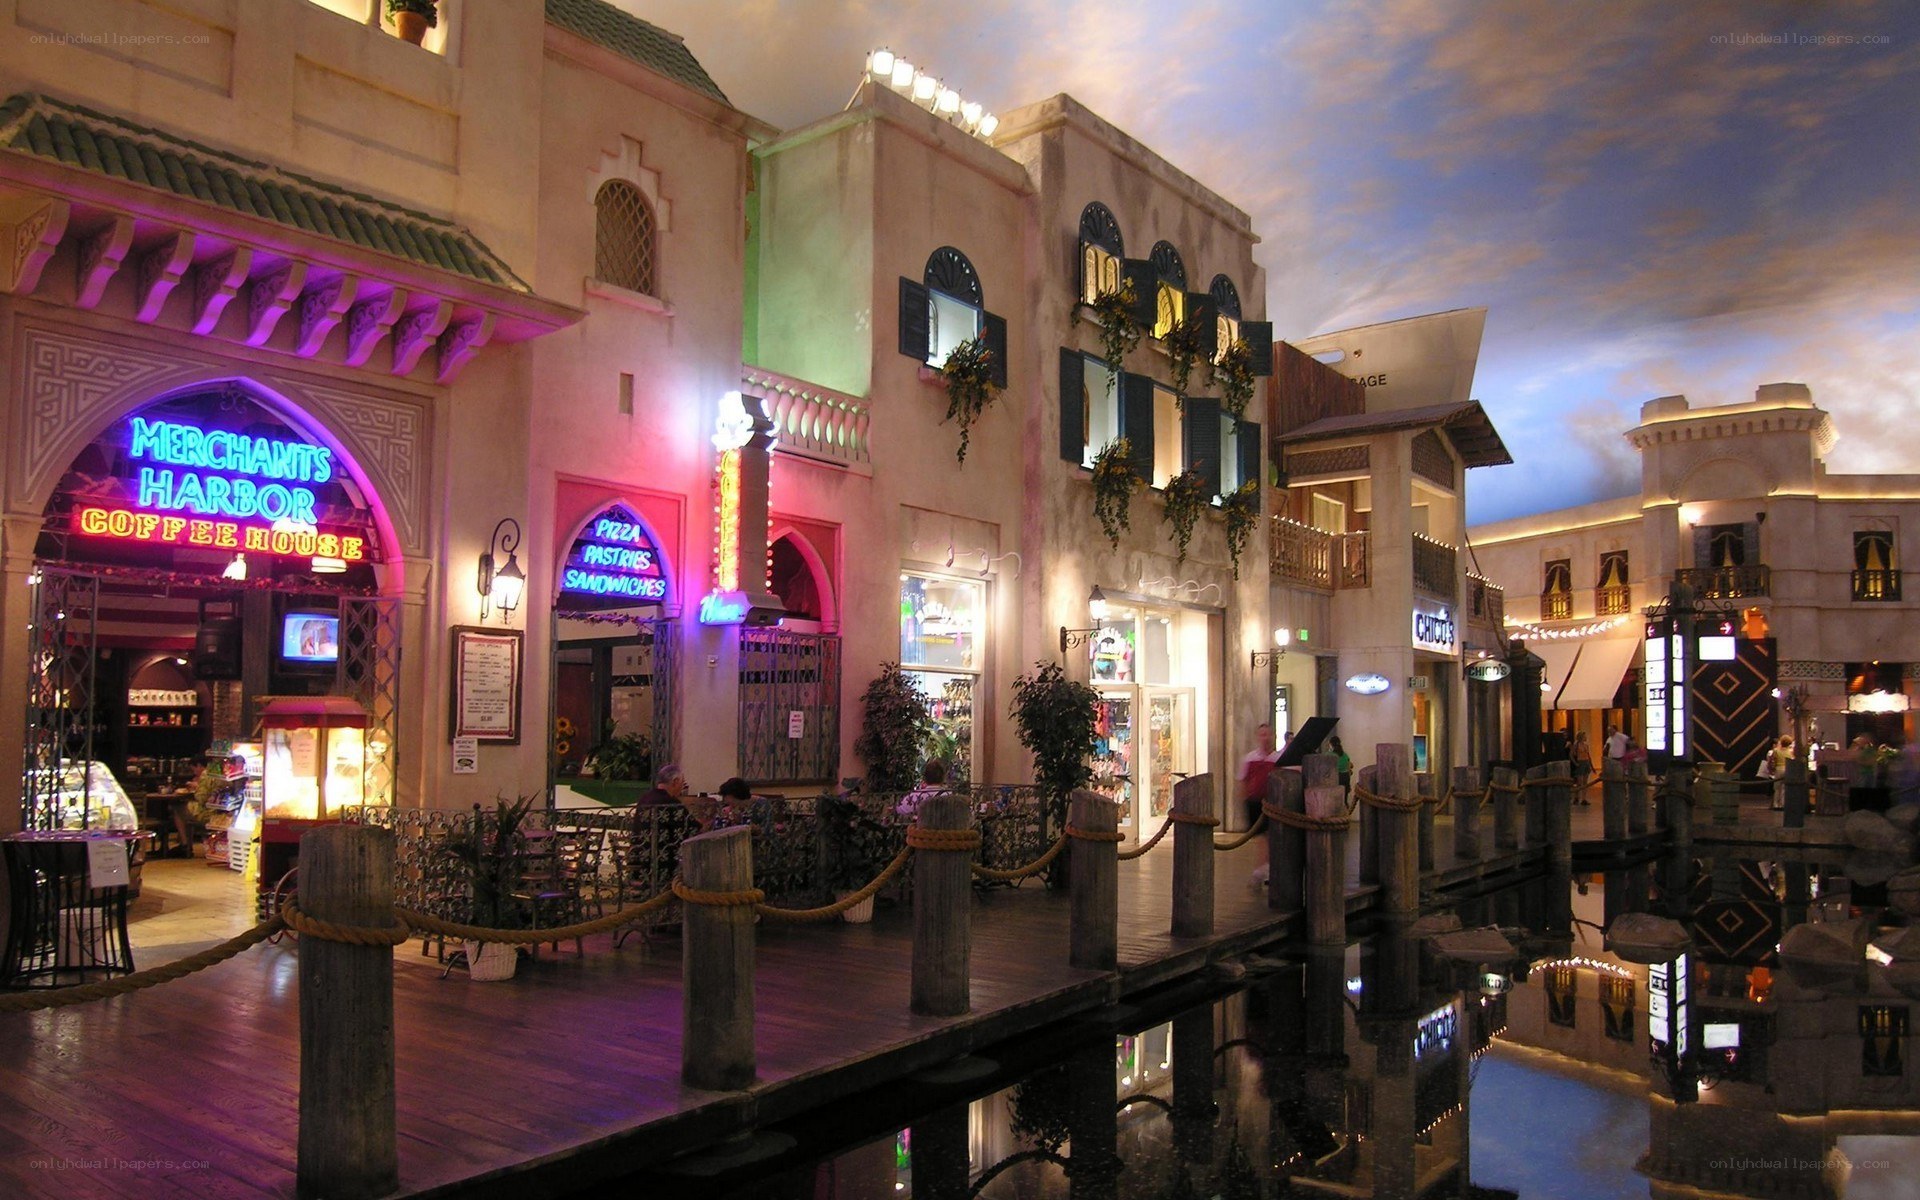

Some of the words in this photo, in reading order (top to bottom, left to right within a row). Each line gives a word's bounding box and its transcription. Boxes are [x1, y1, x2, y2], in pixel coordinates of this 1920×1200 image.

[131, 417, 332, 483] MERCHANTS
[138, 467, 318, 525] HARBOR
[81, 508, 238, 548] COFFEE
[245, 527, 363, 560] HOUSE
[596, 519, 641, 543] PIZZA
[583, 545, 652, 570] PASTRIES
[565, 569, 666, 597] SANDWICHES
